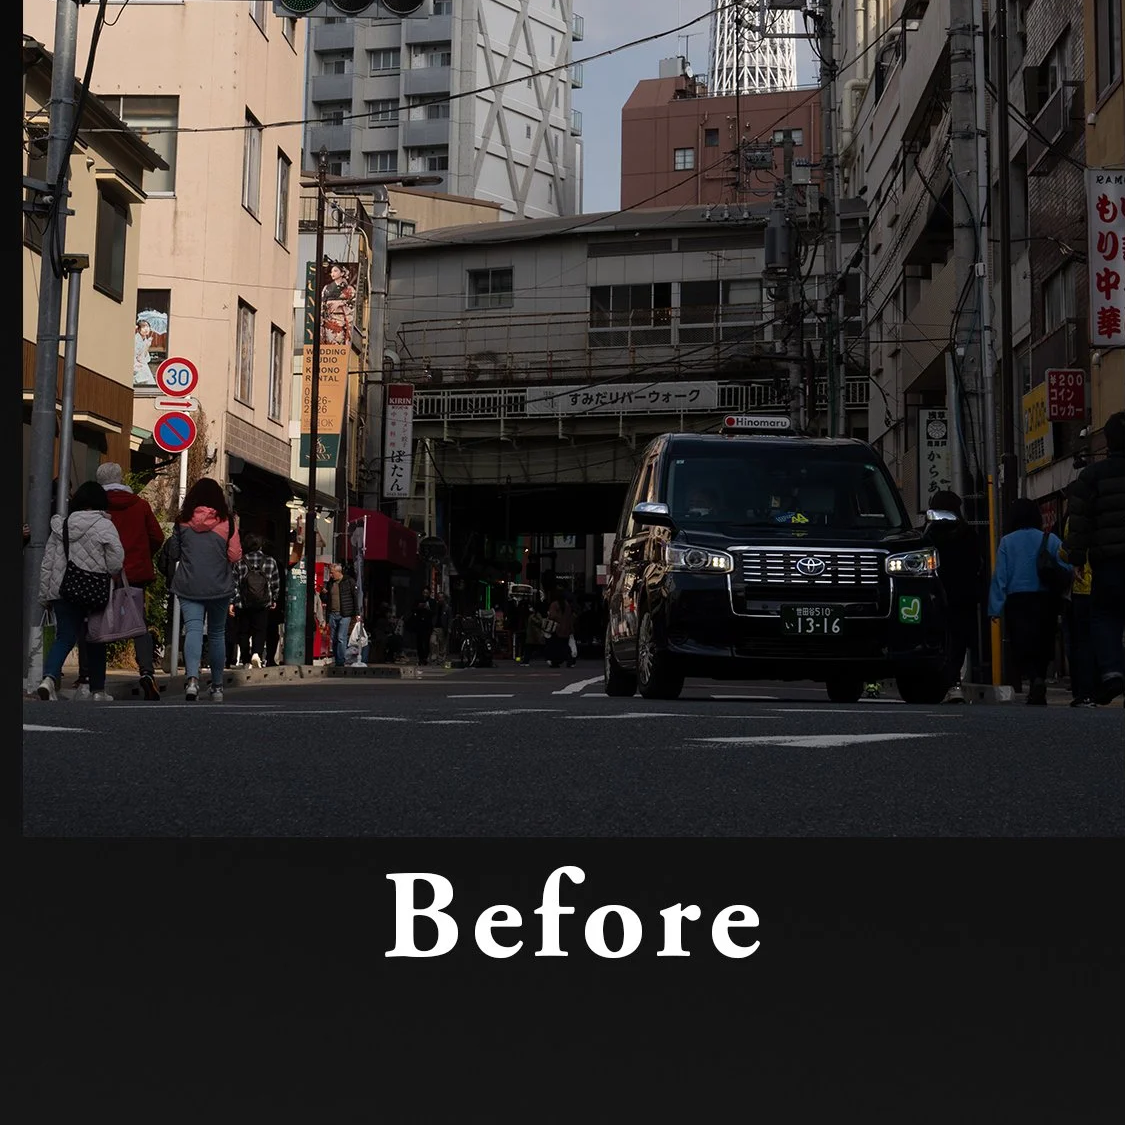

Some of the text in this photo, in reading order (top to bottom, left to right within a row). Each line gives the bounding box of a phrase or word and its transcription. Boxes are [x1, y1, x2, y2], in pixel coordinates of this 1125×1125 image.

[1096, 193, 1121, 339] もり中華
[166, 369, 190, 386] 30
[1050, 375, 1082, 386] ¥200
[389, 397, 412, 405] KIRIN
[569, 389, 700, 406] すみだリバーウォーク
[1050, 389, 1074, 401] コイン
[304, 405, 328, 413] 226
[1051, 403, 1082, 416] ロッカー
[736, 417, 787, 427] Hinomaru
[798, 617, 840, 633] 13-16
